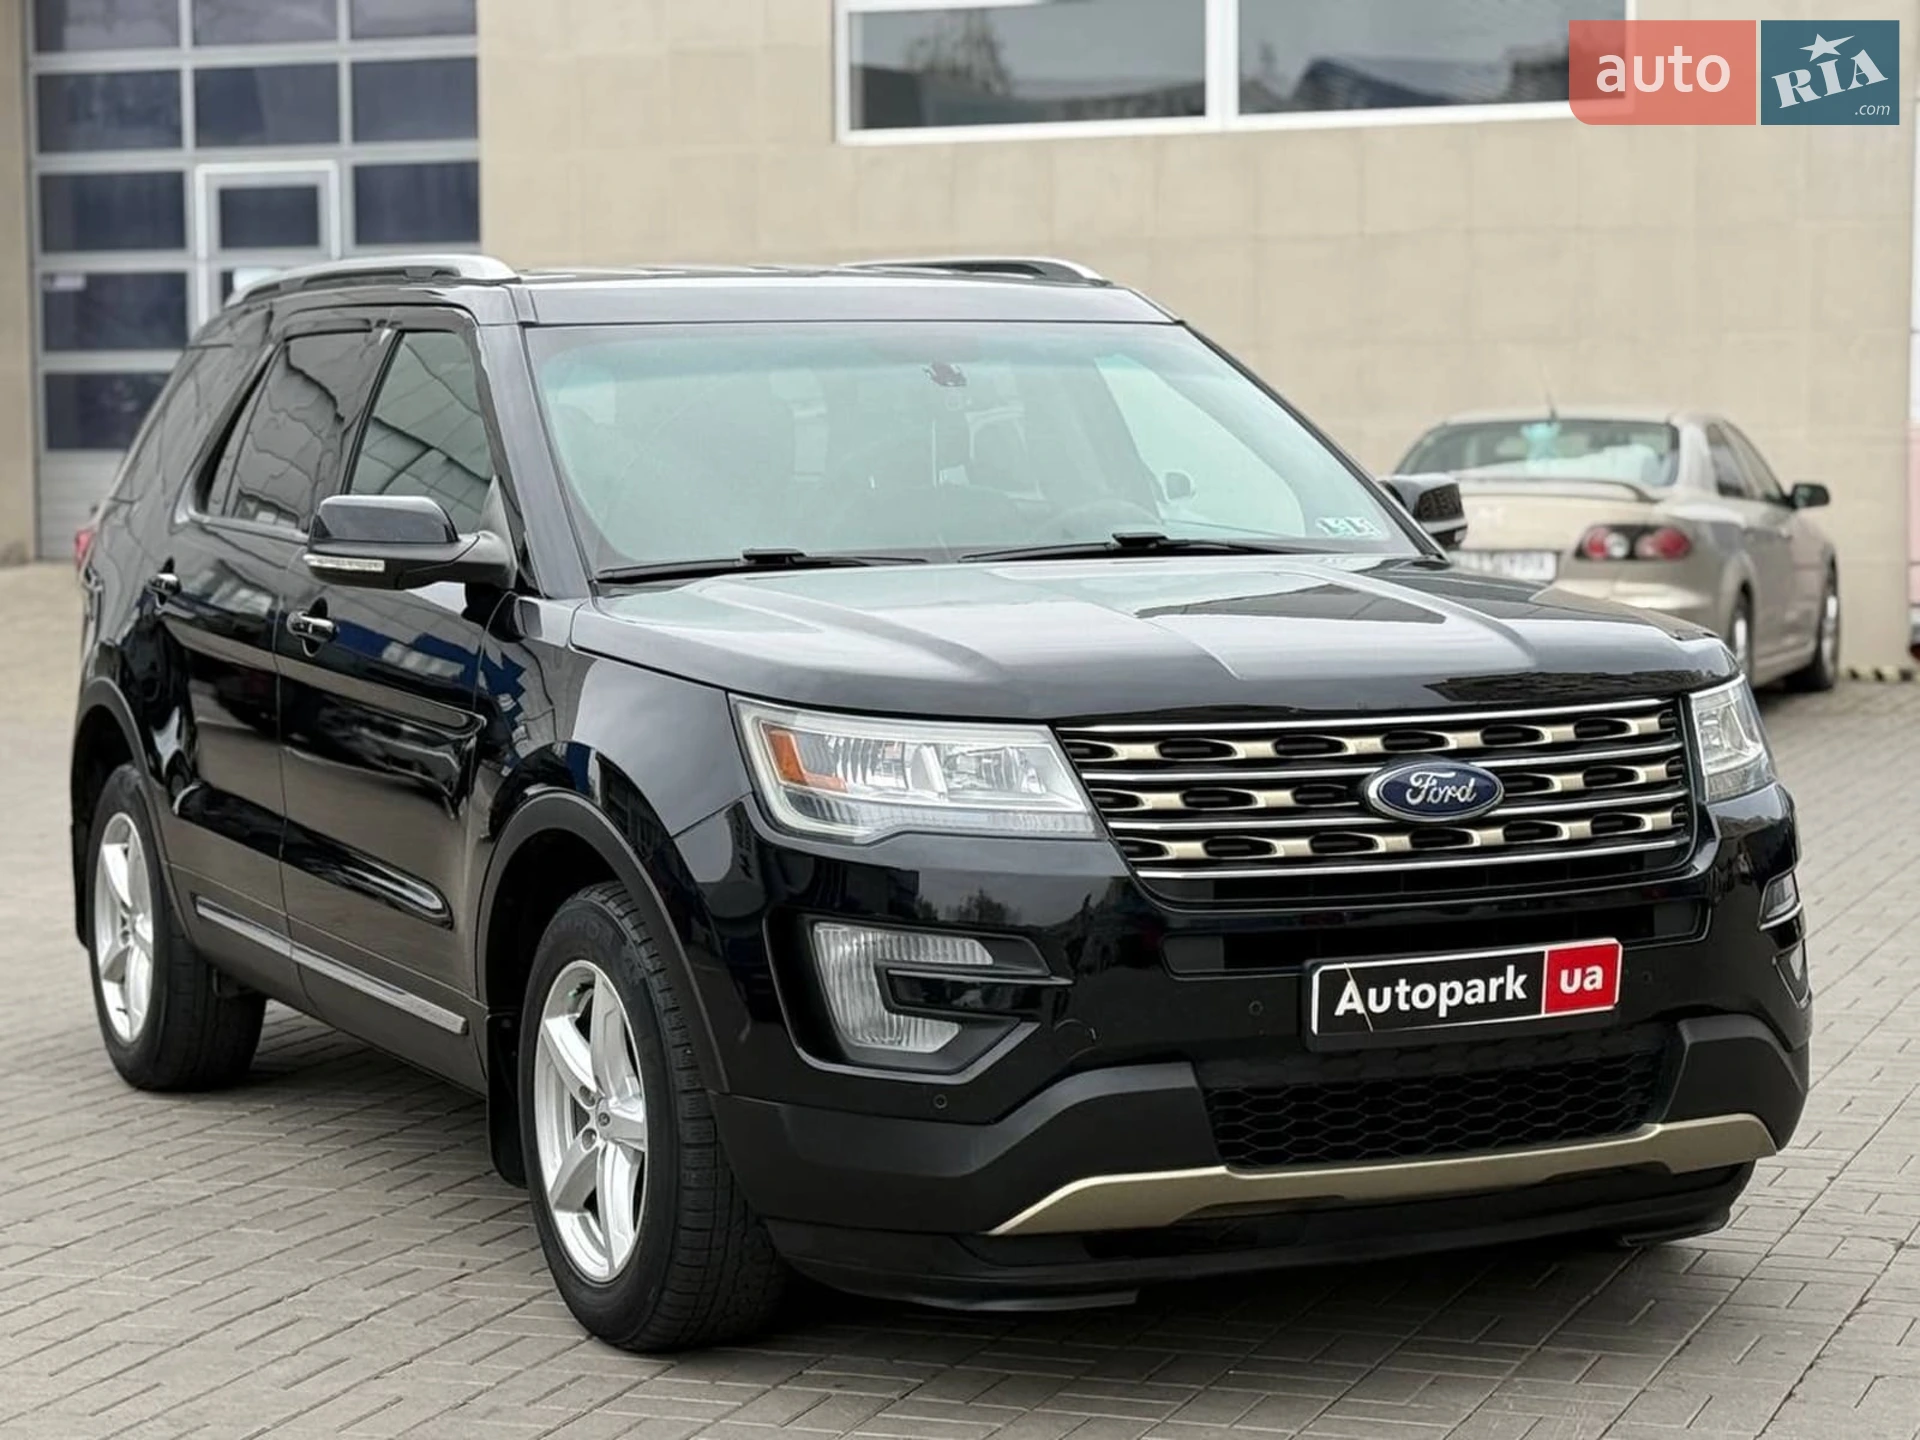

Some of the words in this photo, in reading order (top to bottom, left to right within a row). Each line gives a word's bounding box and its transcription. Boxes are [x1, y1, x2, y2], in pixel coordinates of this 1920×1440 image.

[1406, 771, 1476, 805] Ford
[1334, 964, 1528, 1018] Autopark
[1559, 964, 1604, 995] ua
